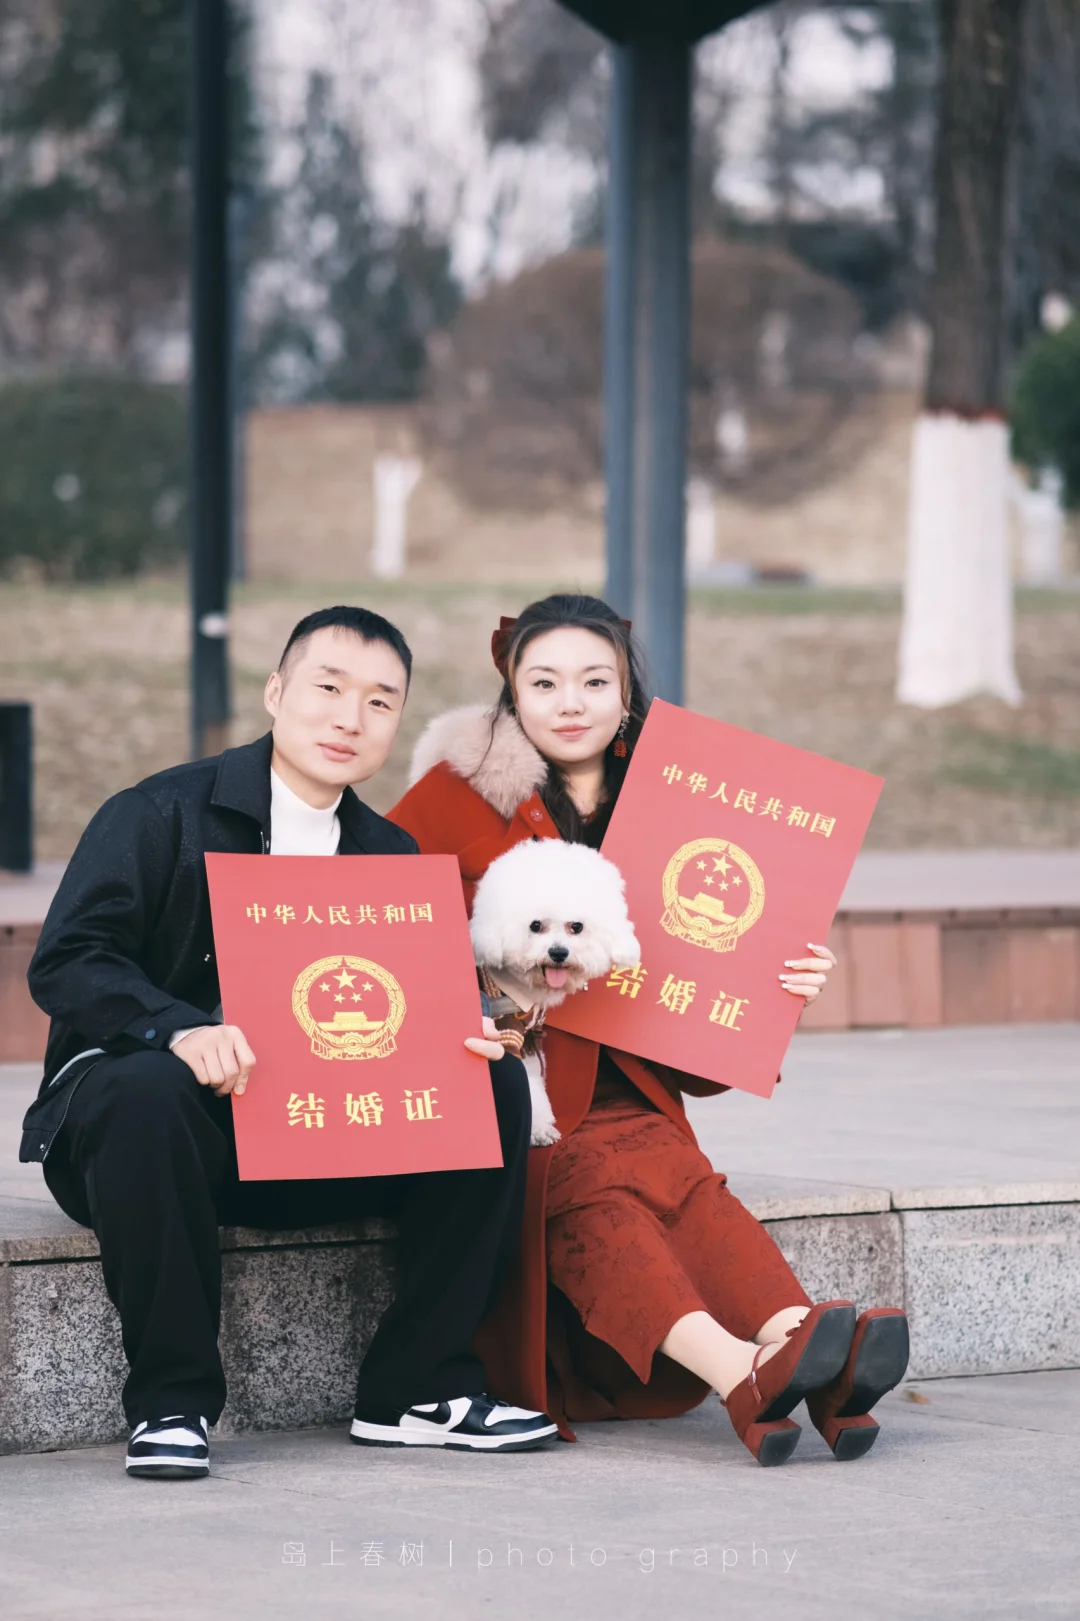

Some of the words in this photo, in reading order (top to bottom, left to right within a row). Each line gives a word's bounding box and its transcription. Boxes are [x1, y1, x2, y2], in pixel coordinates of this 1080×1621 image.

[662, 764, 837, 839] 中华人民共和国
[246, 903, 434, 926] 中华人民共和国
[606, 960, 750, 1032] 结婚证
[286, 1087, 443, 1129] 结婚证
